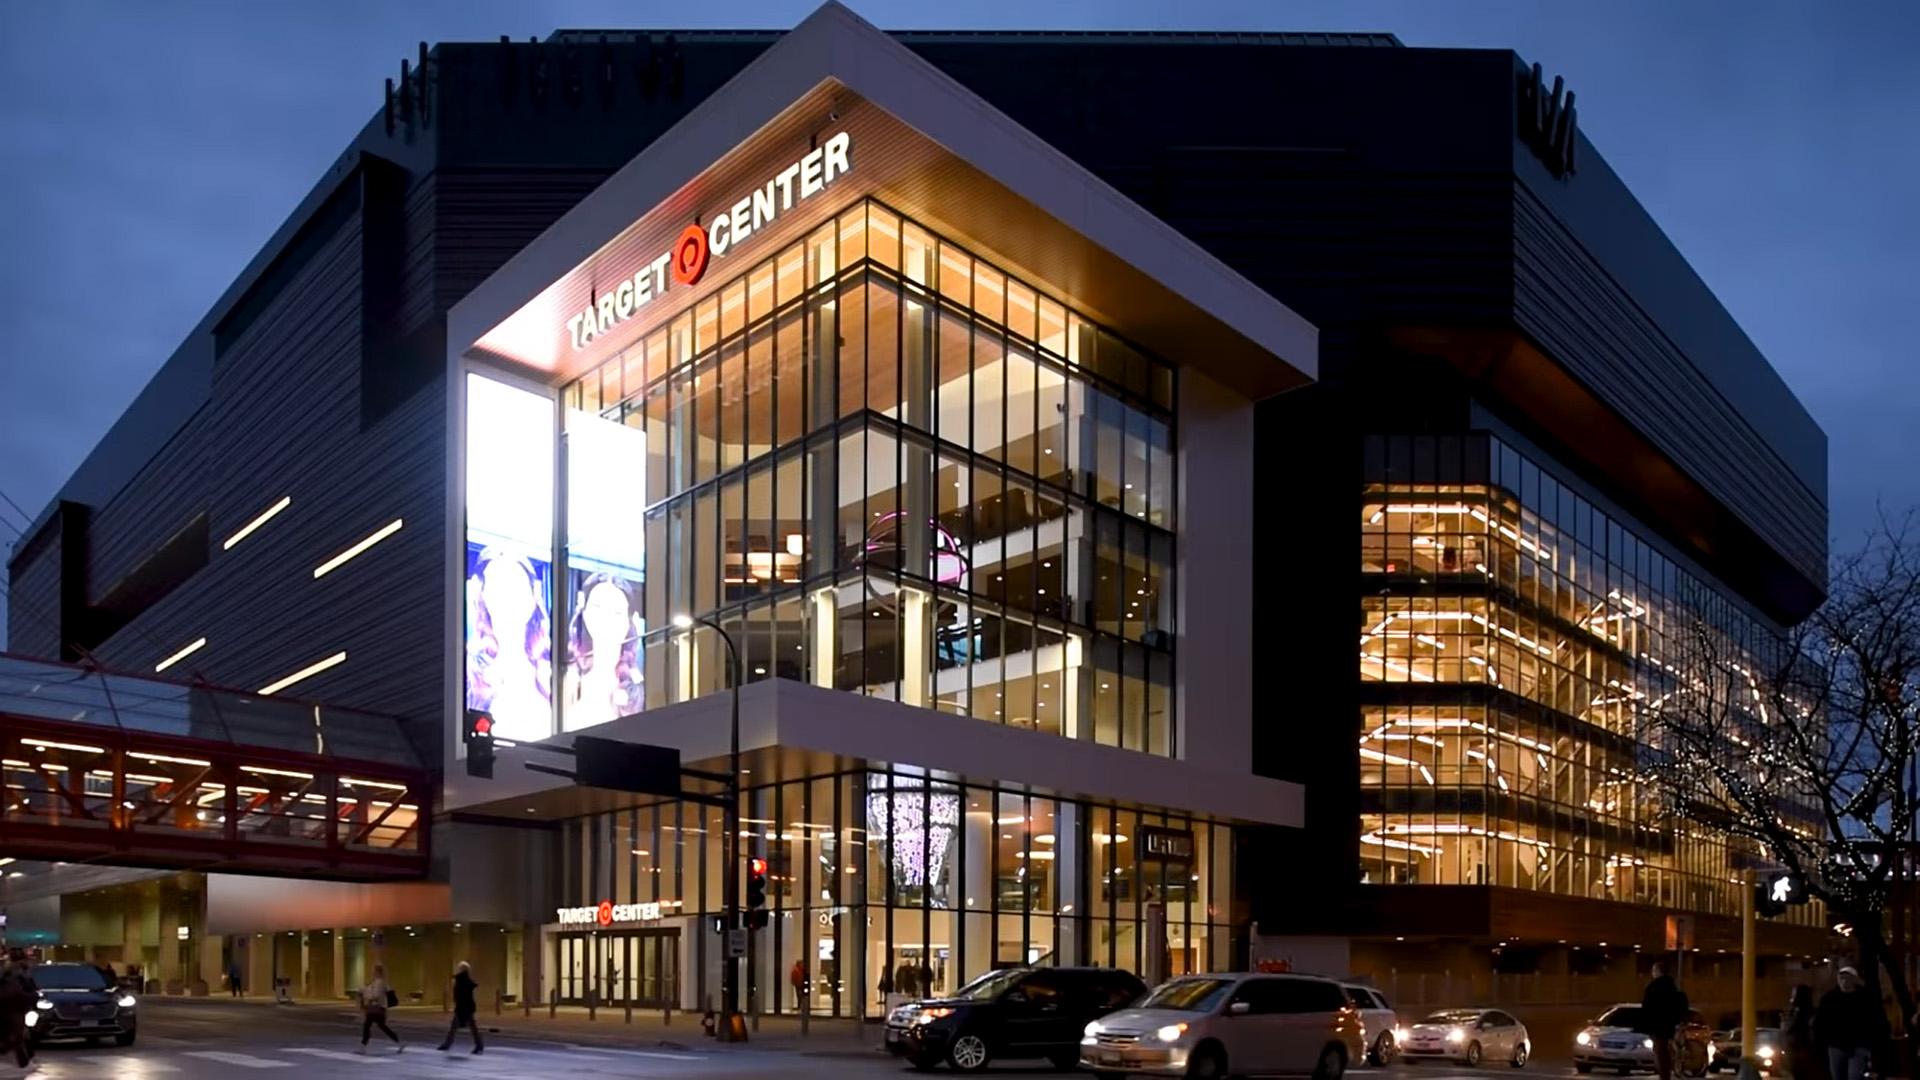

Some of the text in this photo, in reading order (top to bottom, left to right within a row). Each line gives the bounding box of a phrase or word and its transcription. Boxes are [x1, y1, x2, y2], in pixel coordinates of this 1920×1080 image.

[567, 131, 850, 350] TARGET CENTER
[557, 902, 660, 924] TARGET CENTER
